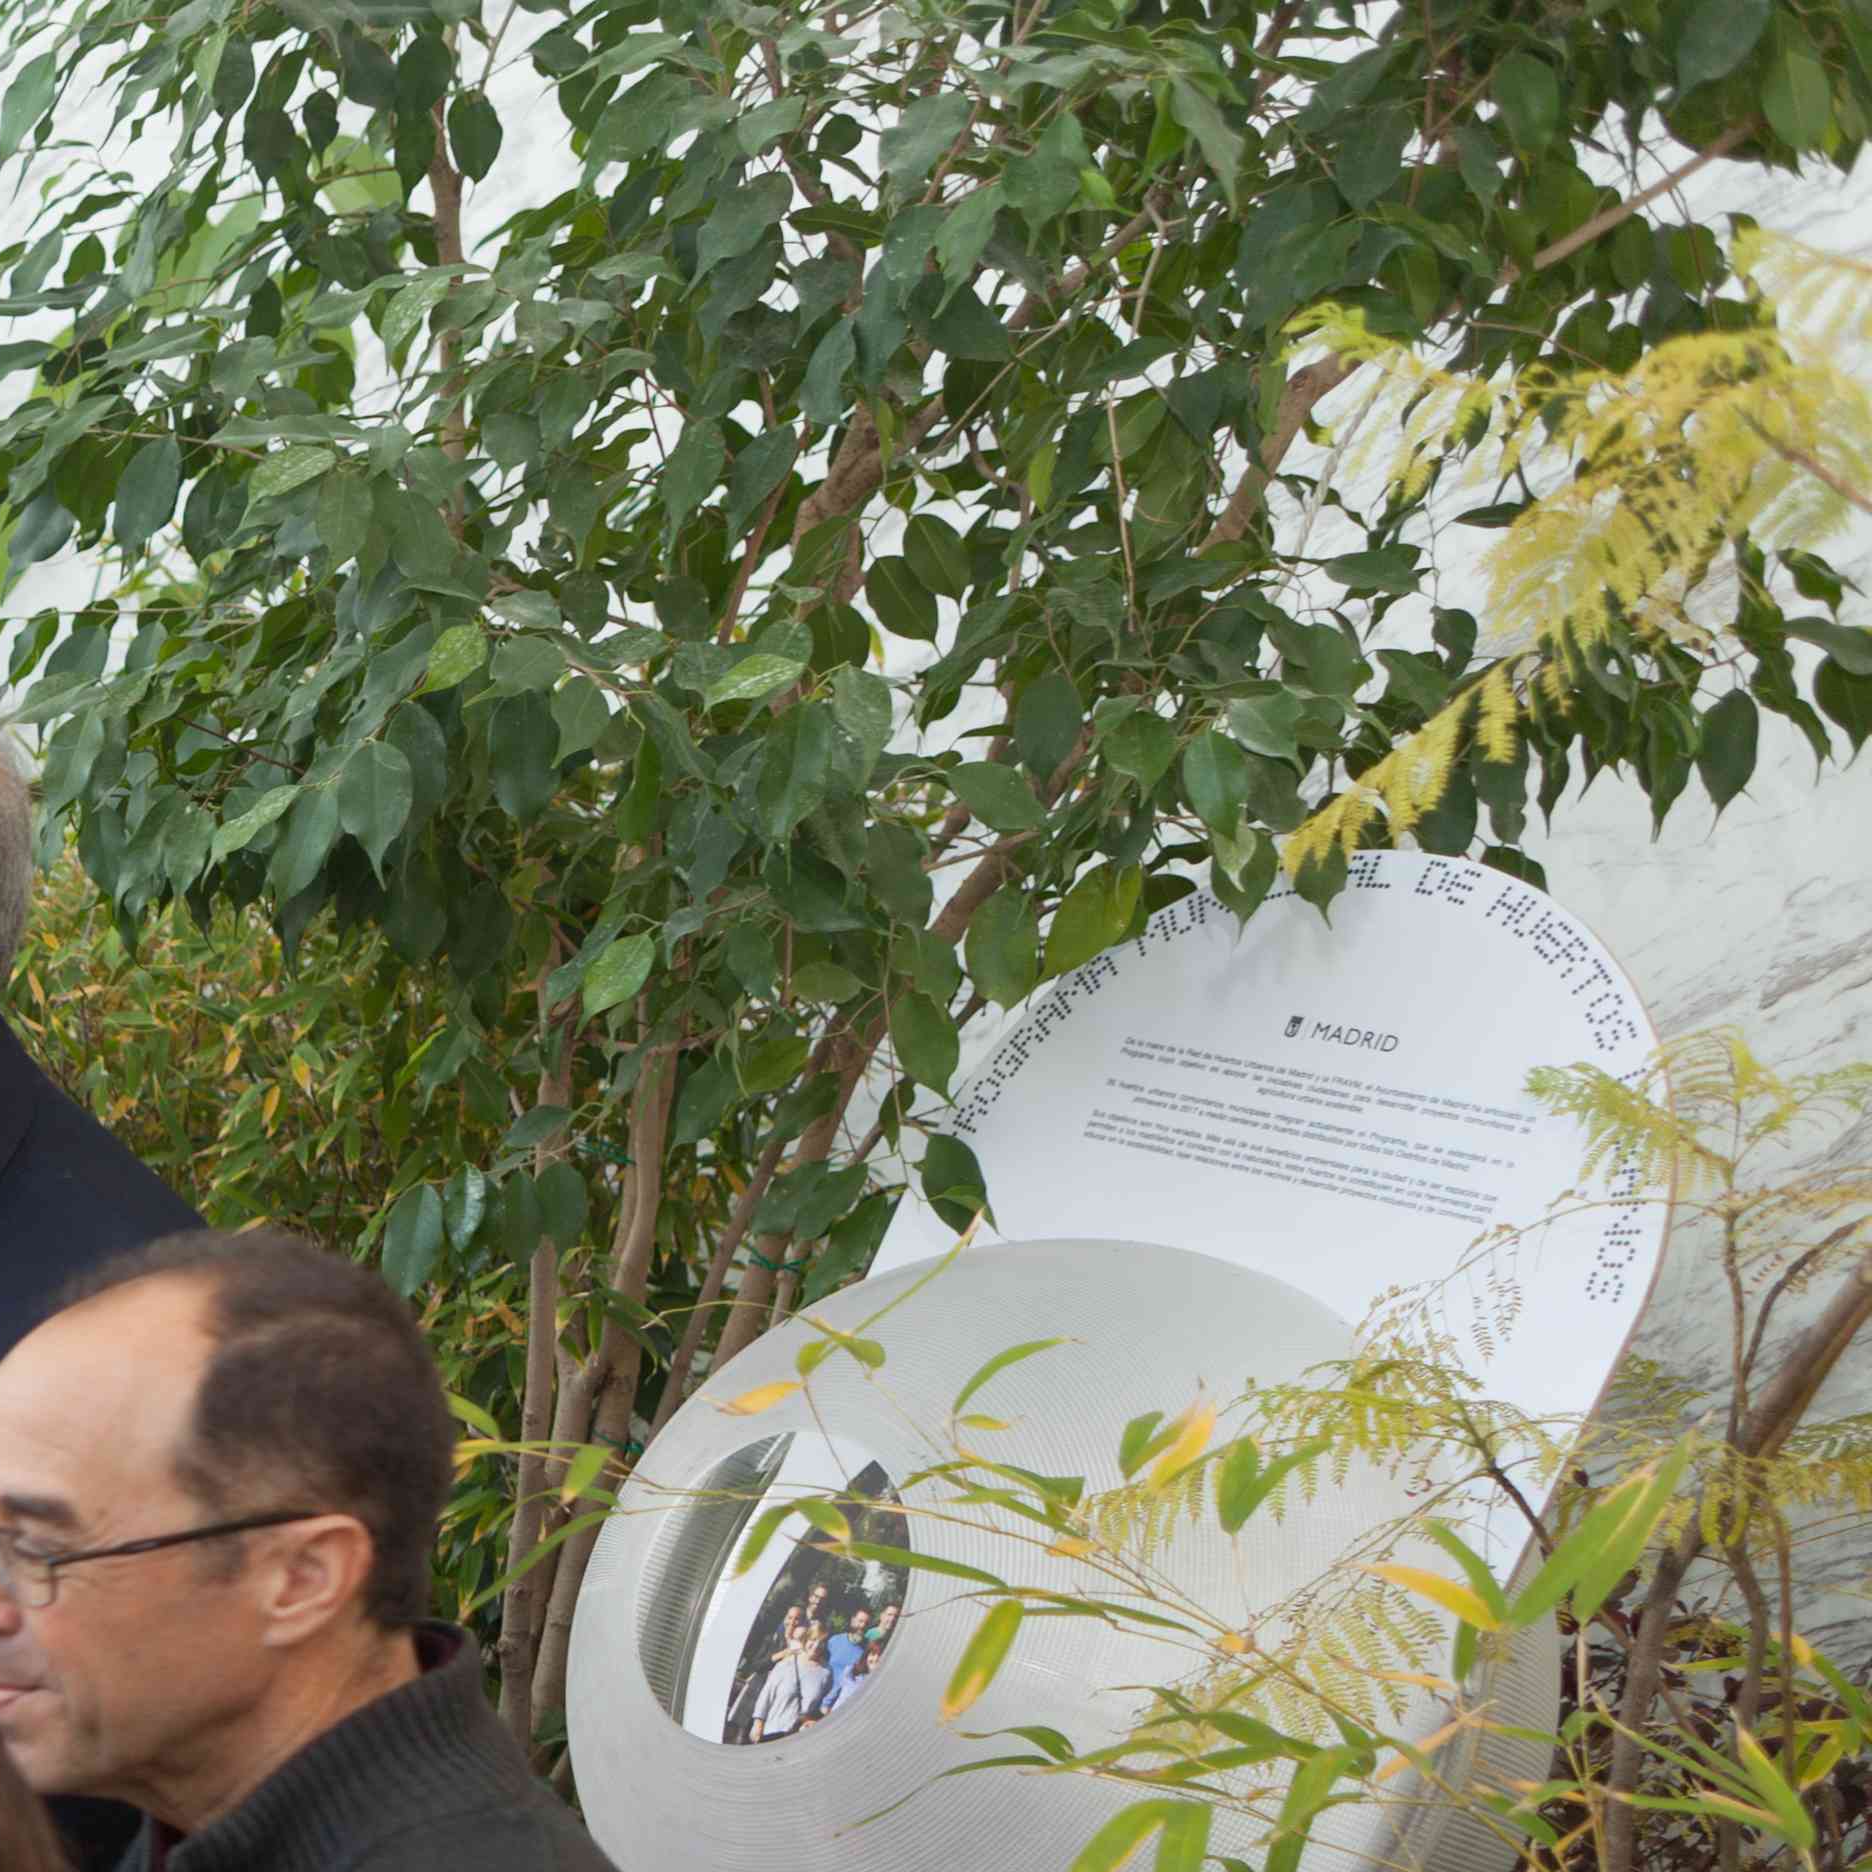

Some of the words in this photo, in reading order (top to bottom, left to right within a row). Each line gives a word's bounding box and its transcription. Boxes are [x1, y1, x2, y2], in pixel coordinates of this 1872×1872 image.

[952, 955, 1119, 1137] ROGRAMA
[1413, 858, 1482, 906] DE
[1485, 884, 1638, 1053] HUERTOS
[1311, 1022, 1400, 1053] MADRID
